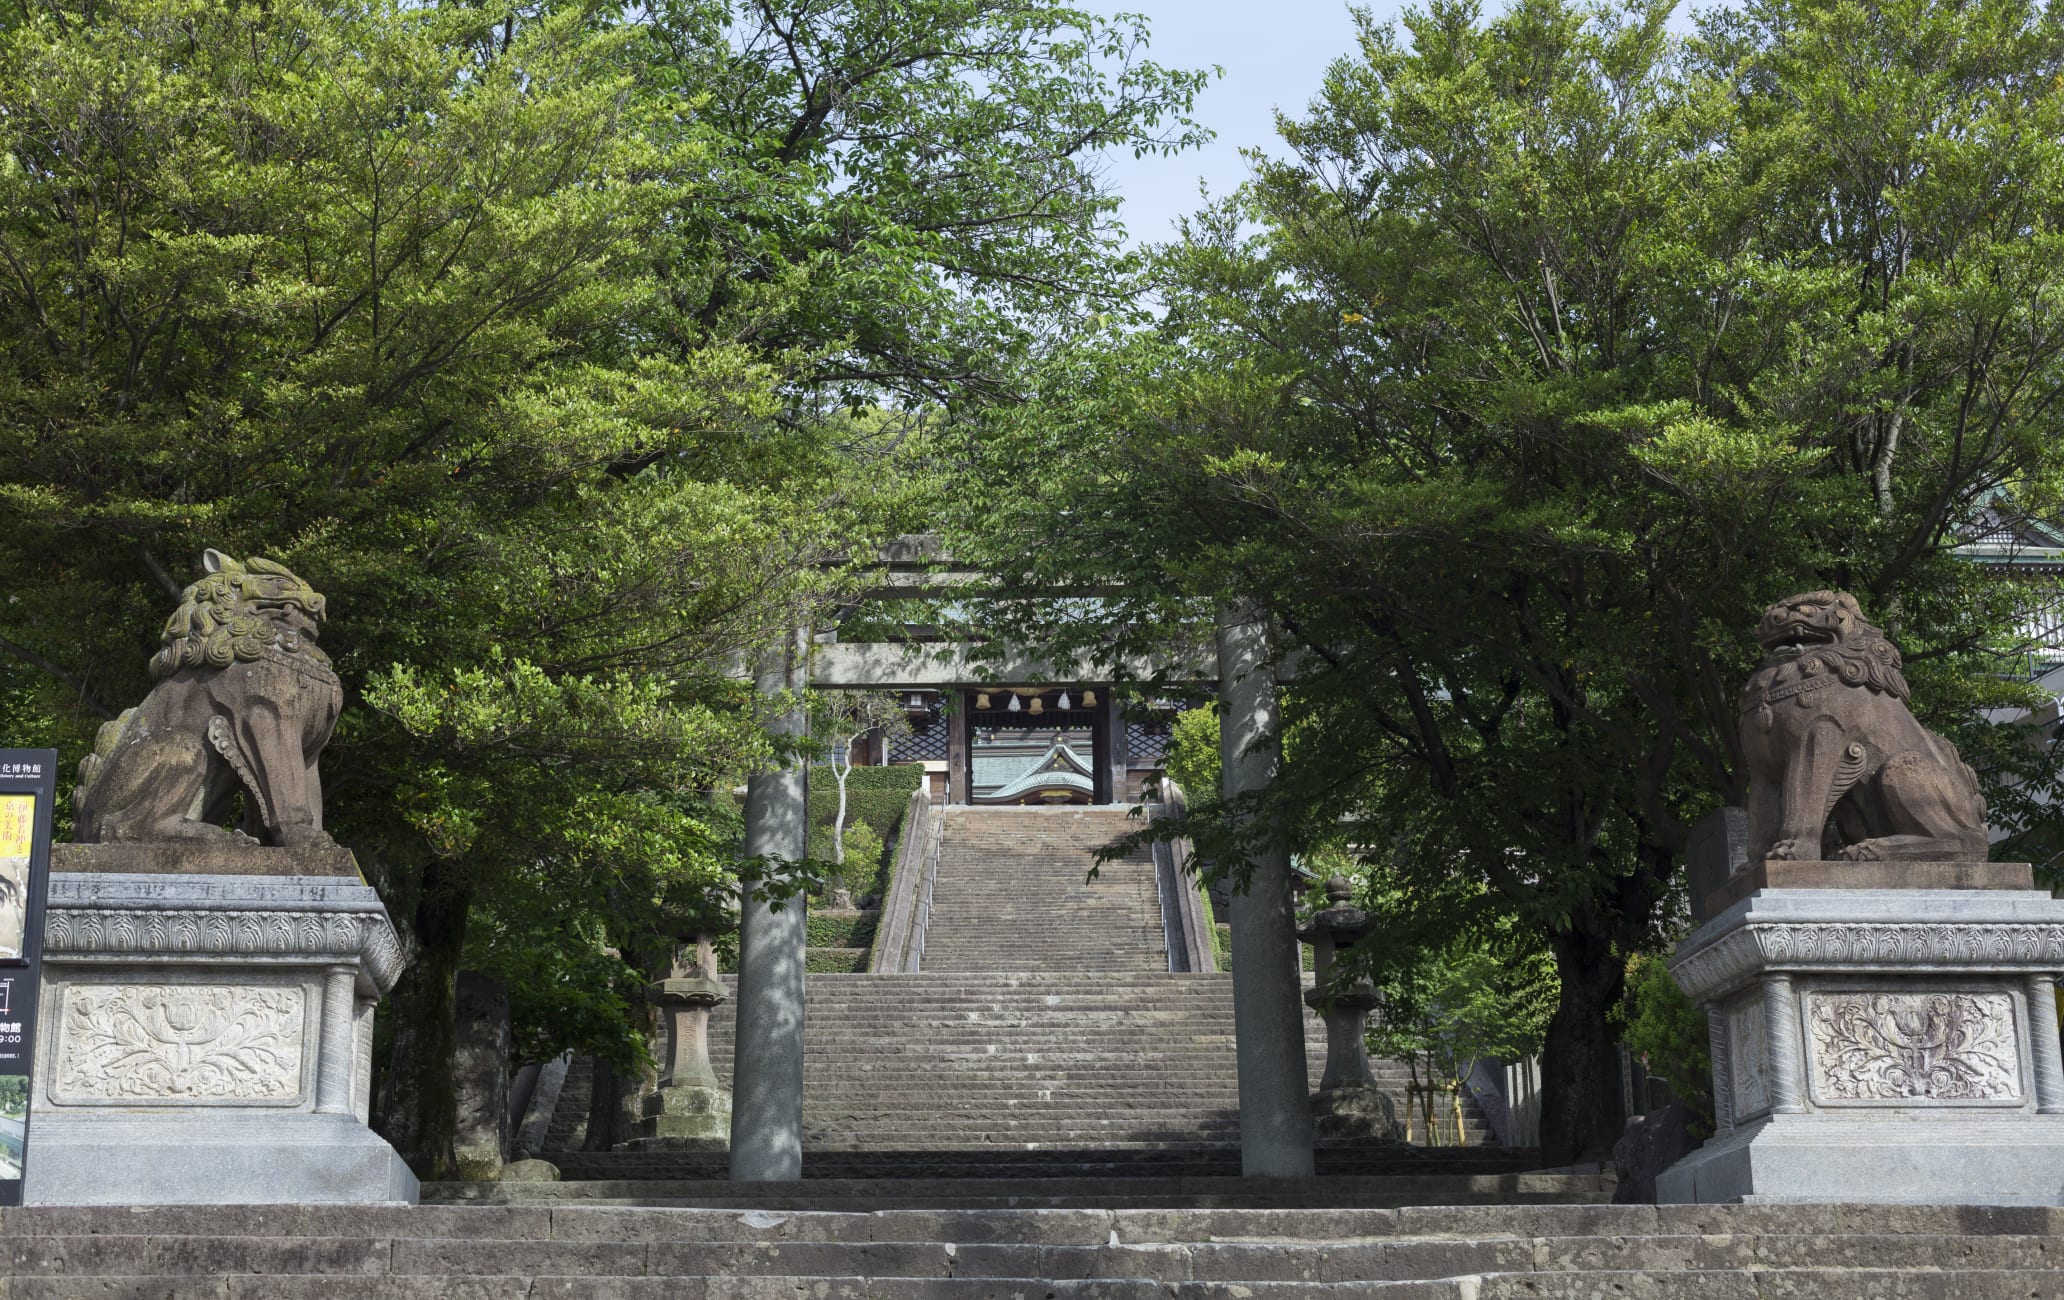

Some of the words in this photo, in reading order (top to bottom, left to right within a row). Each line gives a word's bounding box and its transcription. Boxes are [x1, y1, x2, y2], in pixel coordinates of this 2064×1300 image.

[2, 763, 41, 773] 化博物館
[0, 1022, 22, 1033] 物館
[0, 1035, 21, 1043] 9:00
